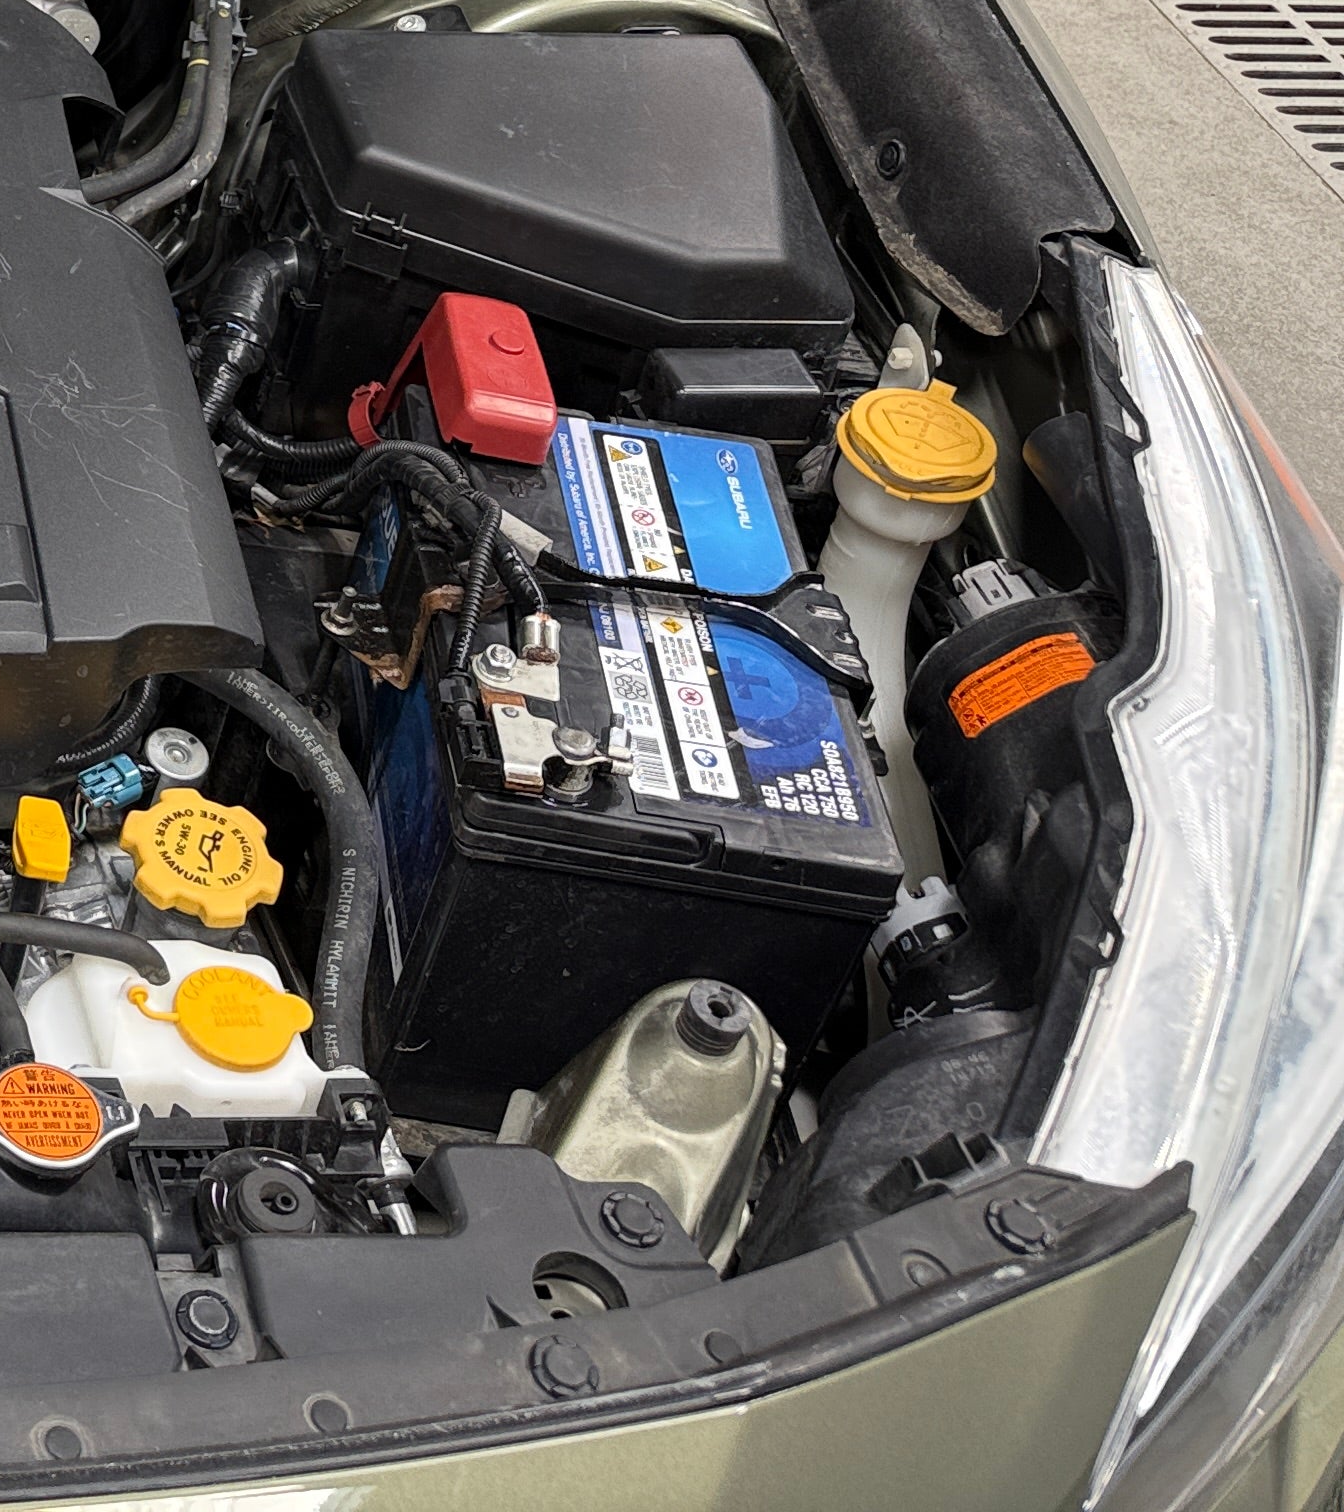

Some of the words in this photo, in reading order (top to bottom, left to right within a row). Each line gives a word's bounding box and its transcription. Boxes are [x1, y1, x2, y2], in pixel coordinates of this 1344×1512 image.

[557, 432, 575, 469] Distributed
[570, 483, 584, 509] Subaru
[726, 475, 753, 530] SUBARU
[575, 510, 585, 518] of
[692, 611, 714, 653] POISON
[776, 776, 795, 794] Ah
[794, 773, 813, 791] RC
[811, 768, 832, 792] CCA
[760, 784, 782, 809] EFB
[782, 796, 801, 812] 76
[800, 793, 820, 815] 120
[818, 795, 839, 818] 750
[199, 809, 228, 826] SEE
[175, 823, 192, 856] 5W-30
[231, 828, 253, 875] ENGINE
[159, 850, 211, 887] MANUAL
[218, 872, 241, 886] OIL
[333, 867, 356, 930] NICHIRIN
[182, 968, 278, 1000] COOLANT
[214, 1016, 264, 1027] MANUAL
[26, 1083, 75, 1095] WARNING
[2, 1110, 26, 1119] NEVER
[51, 1110, 72, 1119] WHEN
